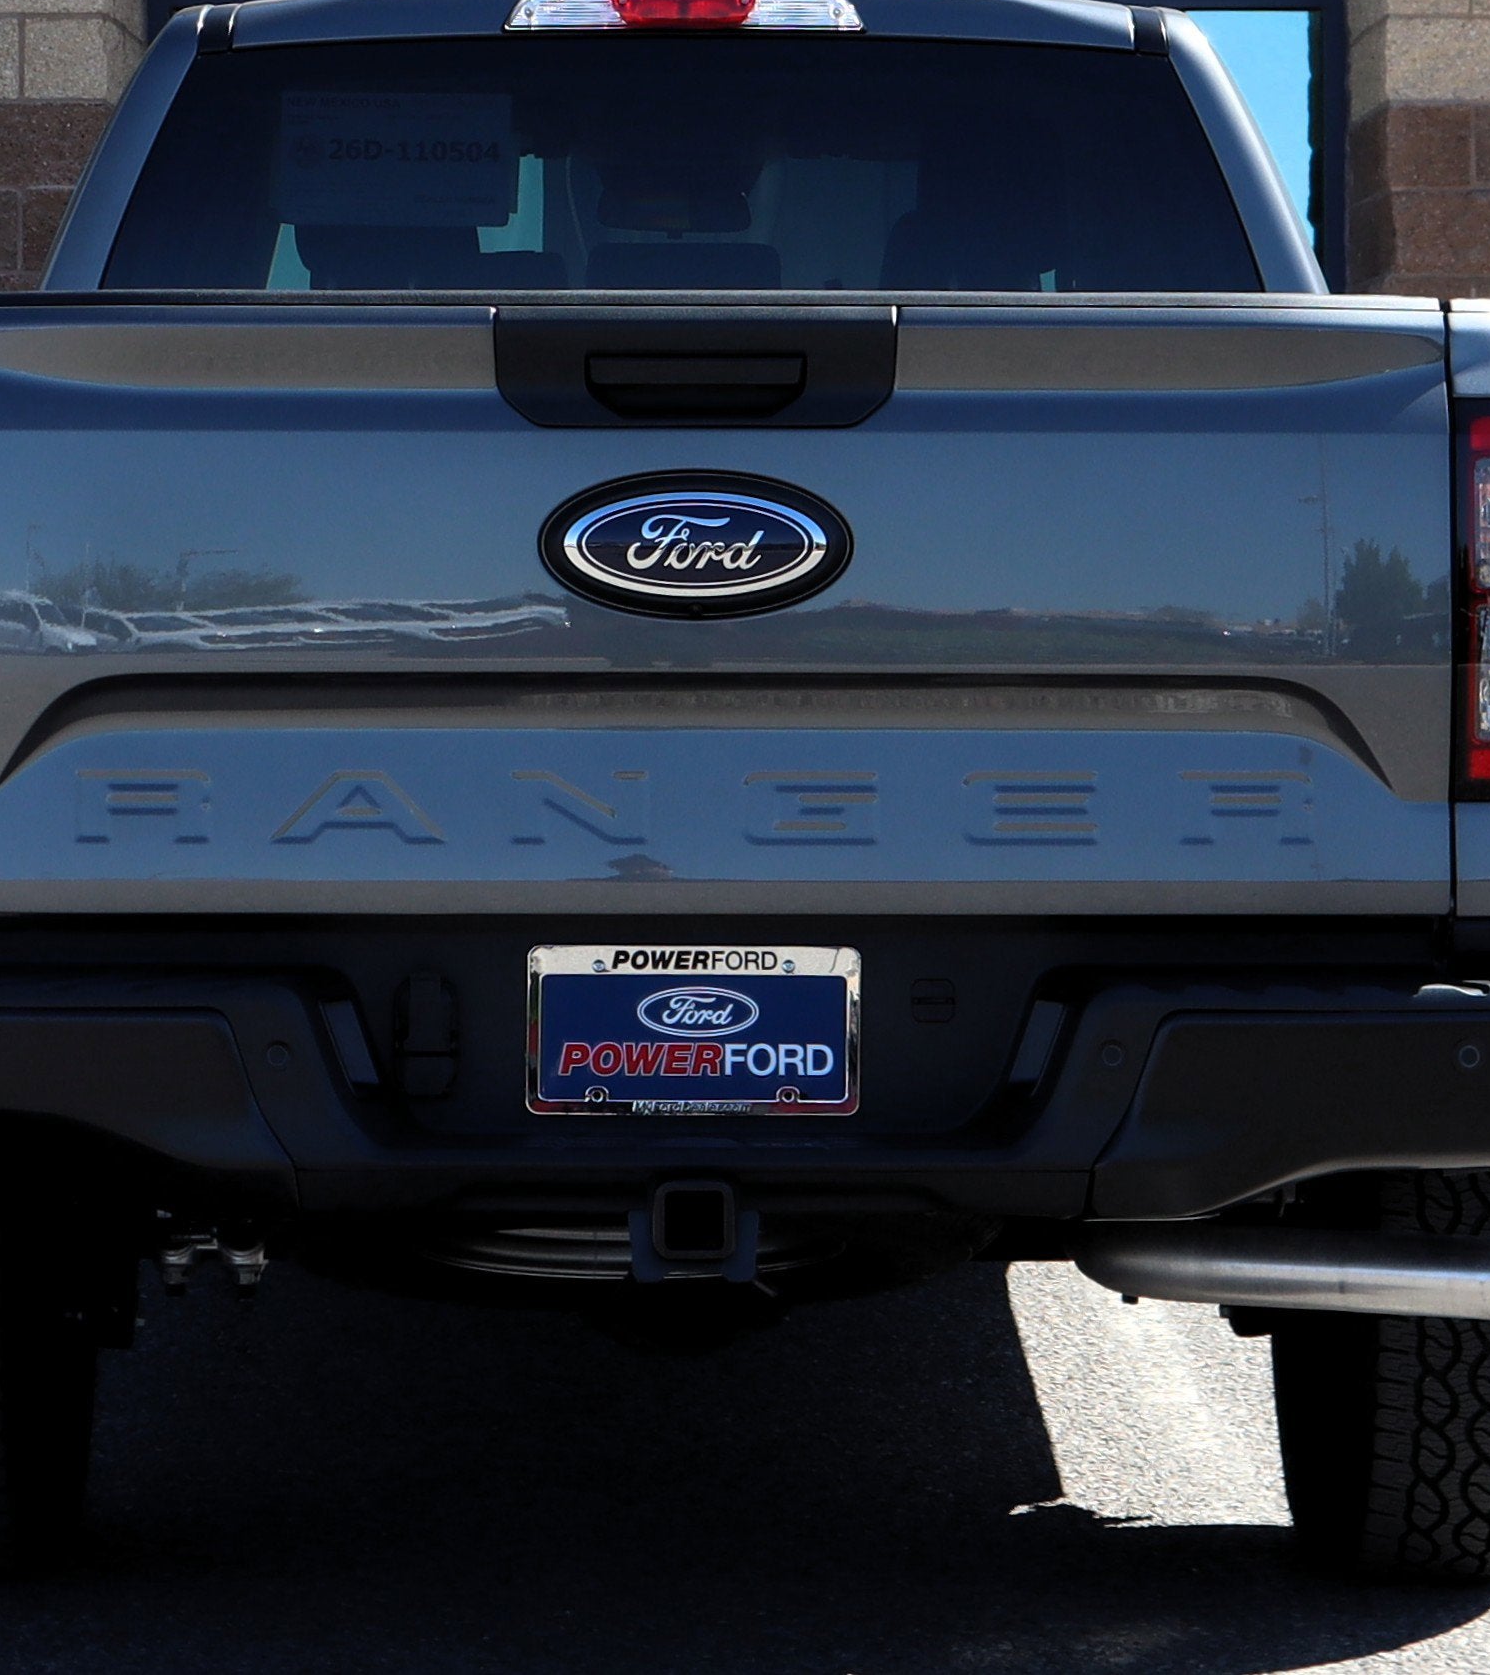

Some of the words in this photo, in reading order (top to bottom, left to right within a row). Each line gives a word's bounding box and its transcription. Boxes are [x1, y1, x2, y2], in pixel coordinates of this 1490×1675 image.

[287, 97, 316, 108] NEW
[320, 97, 371, 108] MEXICO
[374, 98, 401, 109] USA
[328, 137, 501, 164] 26D-110504
[626, 513, 765, 570] Ford
[76, 769, 1313, 846] RANGER
[612, 950, 778, 971] POWERFORD
[661, 996, 734, 1025] Ford
[558, 1041, 835, 1077] POWERFORD
